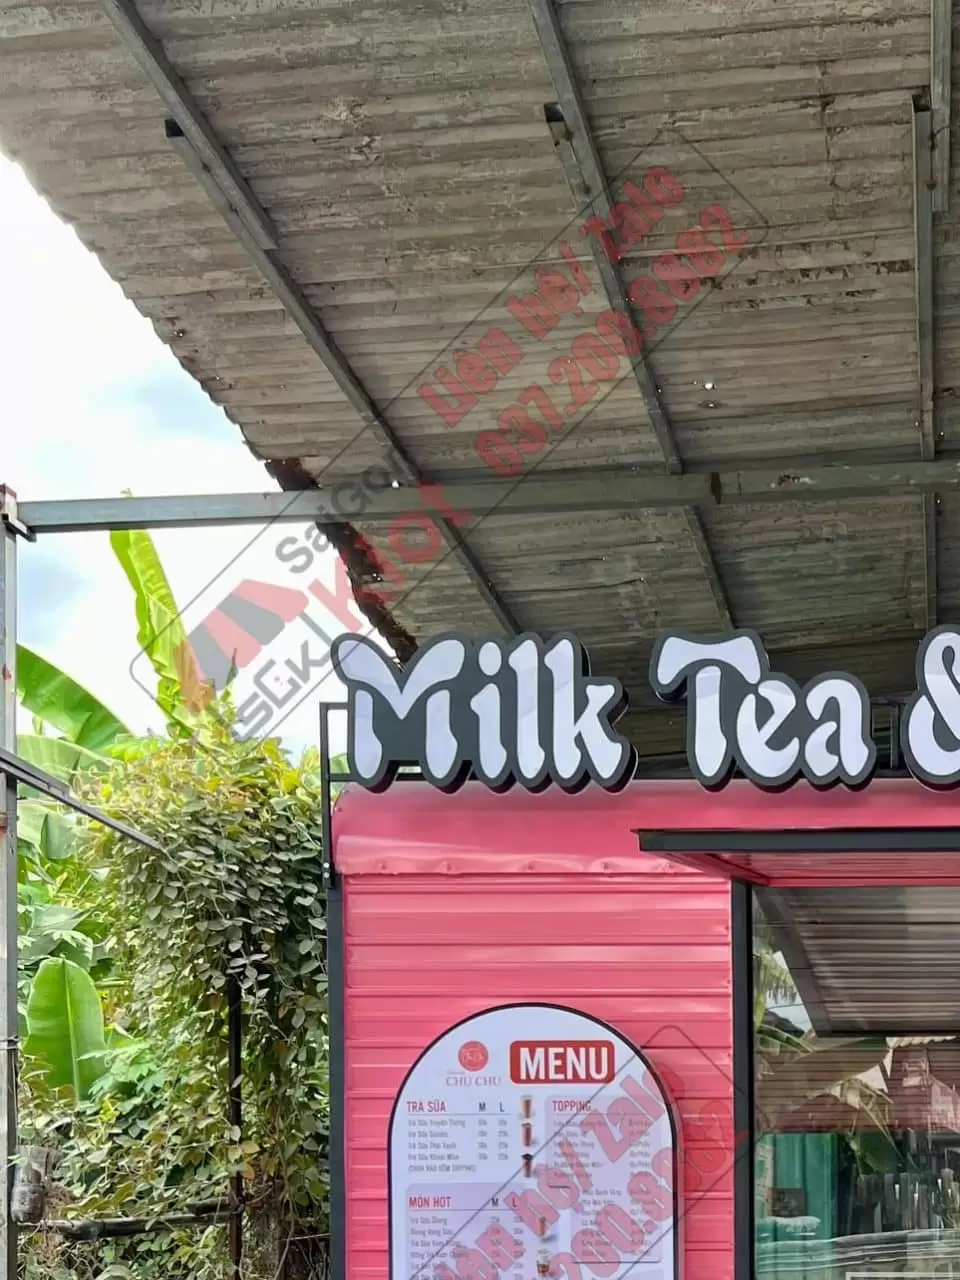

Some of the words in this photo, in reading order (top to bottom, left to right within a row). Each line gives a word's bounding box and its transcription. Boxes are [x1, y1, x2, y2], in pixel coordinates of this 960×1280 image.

[337, 636, 625, 781] Milk
[656, 634, 869, 779] Tea
[520, 1047, 609, 1080] MENU
[478, 1101, 486, 1112] M
[499, 1101, 505, 1112] L
[552, 1100, 591, 1112] TOPPING
